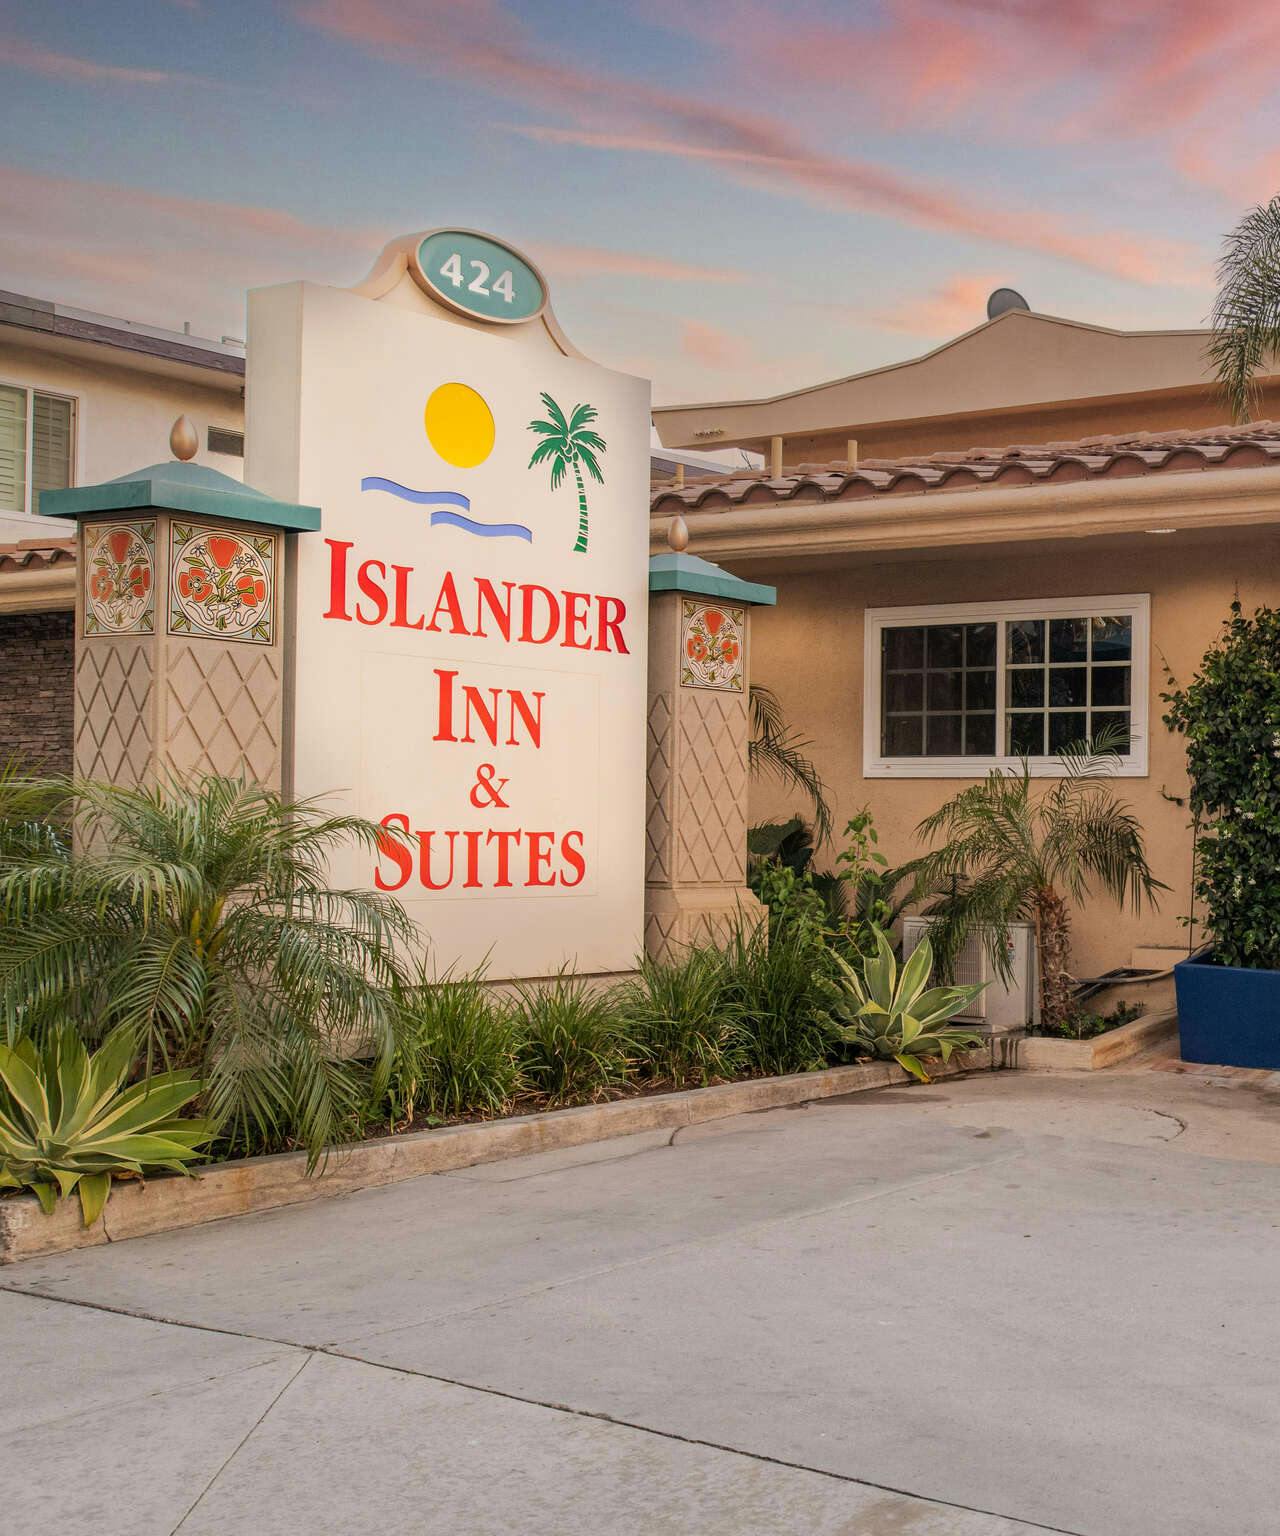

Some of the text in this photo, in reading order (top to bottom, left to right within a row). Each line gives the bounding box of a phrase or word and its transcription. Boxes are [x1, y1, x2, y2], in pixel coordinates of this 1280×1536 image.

[439, 253, 516, 304] 424
[322, 538, 630, 655] ISLANDER
[432, 668, 546, 749] INN
[469, 763, 510, 809] &
[374, 813, 587, 892] SUITES
